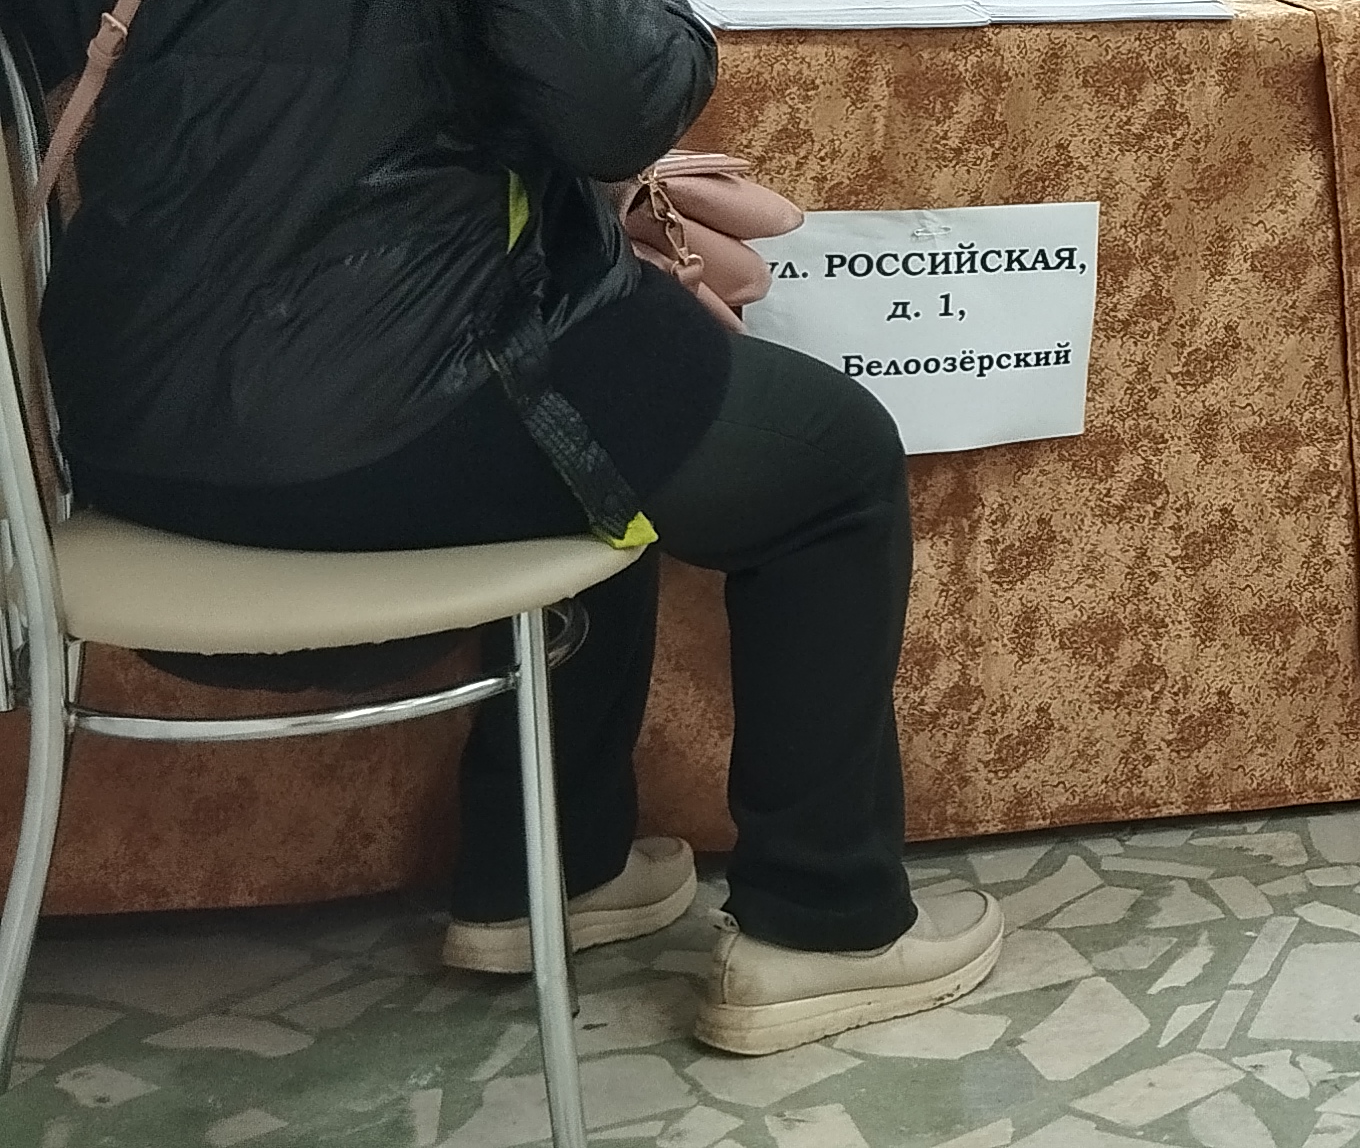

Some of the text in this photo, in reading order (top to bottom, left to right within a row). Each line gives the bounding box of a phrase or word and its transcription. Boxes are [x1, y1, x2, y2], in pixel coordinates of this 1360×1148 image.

[824, 243, 1086, 278] РОССИЙСКАЯ,
[886, 293, 966, 322] д. 1,
